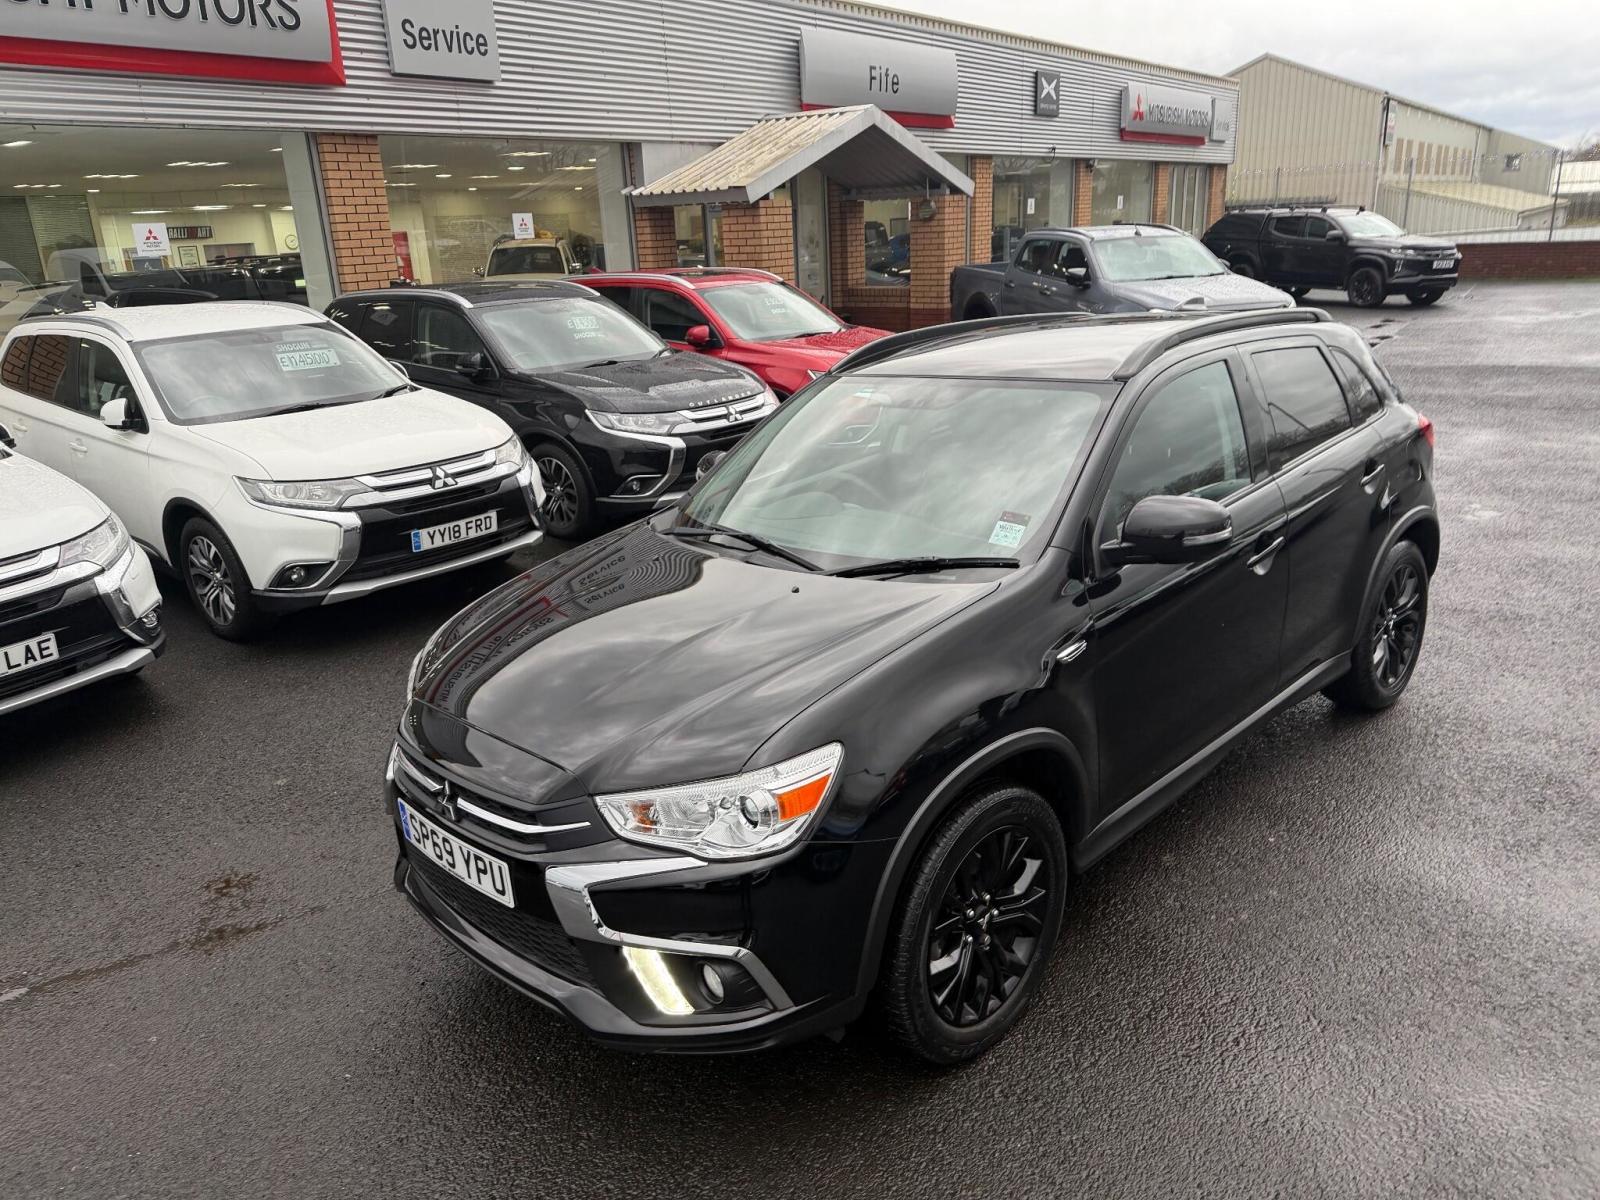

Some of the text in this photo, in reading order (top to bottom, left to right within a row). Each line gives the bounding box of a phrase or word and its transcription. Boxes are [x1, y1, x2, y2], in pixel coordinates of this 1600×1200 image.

[401, 18, 489, 57] Service
[869, 65, 900, 94] Fife
[1149, 103, 1184, 126] MITSUBISHI
[688, 391, 752, 407] OUTLANDER
[427, 515, 492, 545] YY18 FRD
[3, 637, 54, 670] LAE
[409, 813, 506, 897] SP69 YPU
